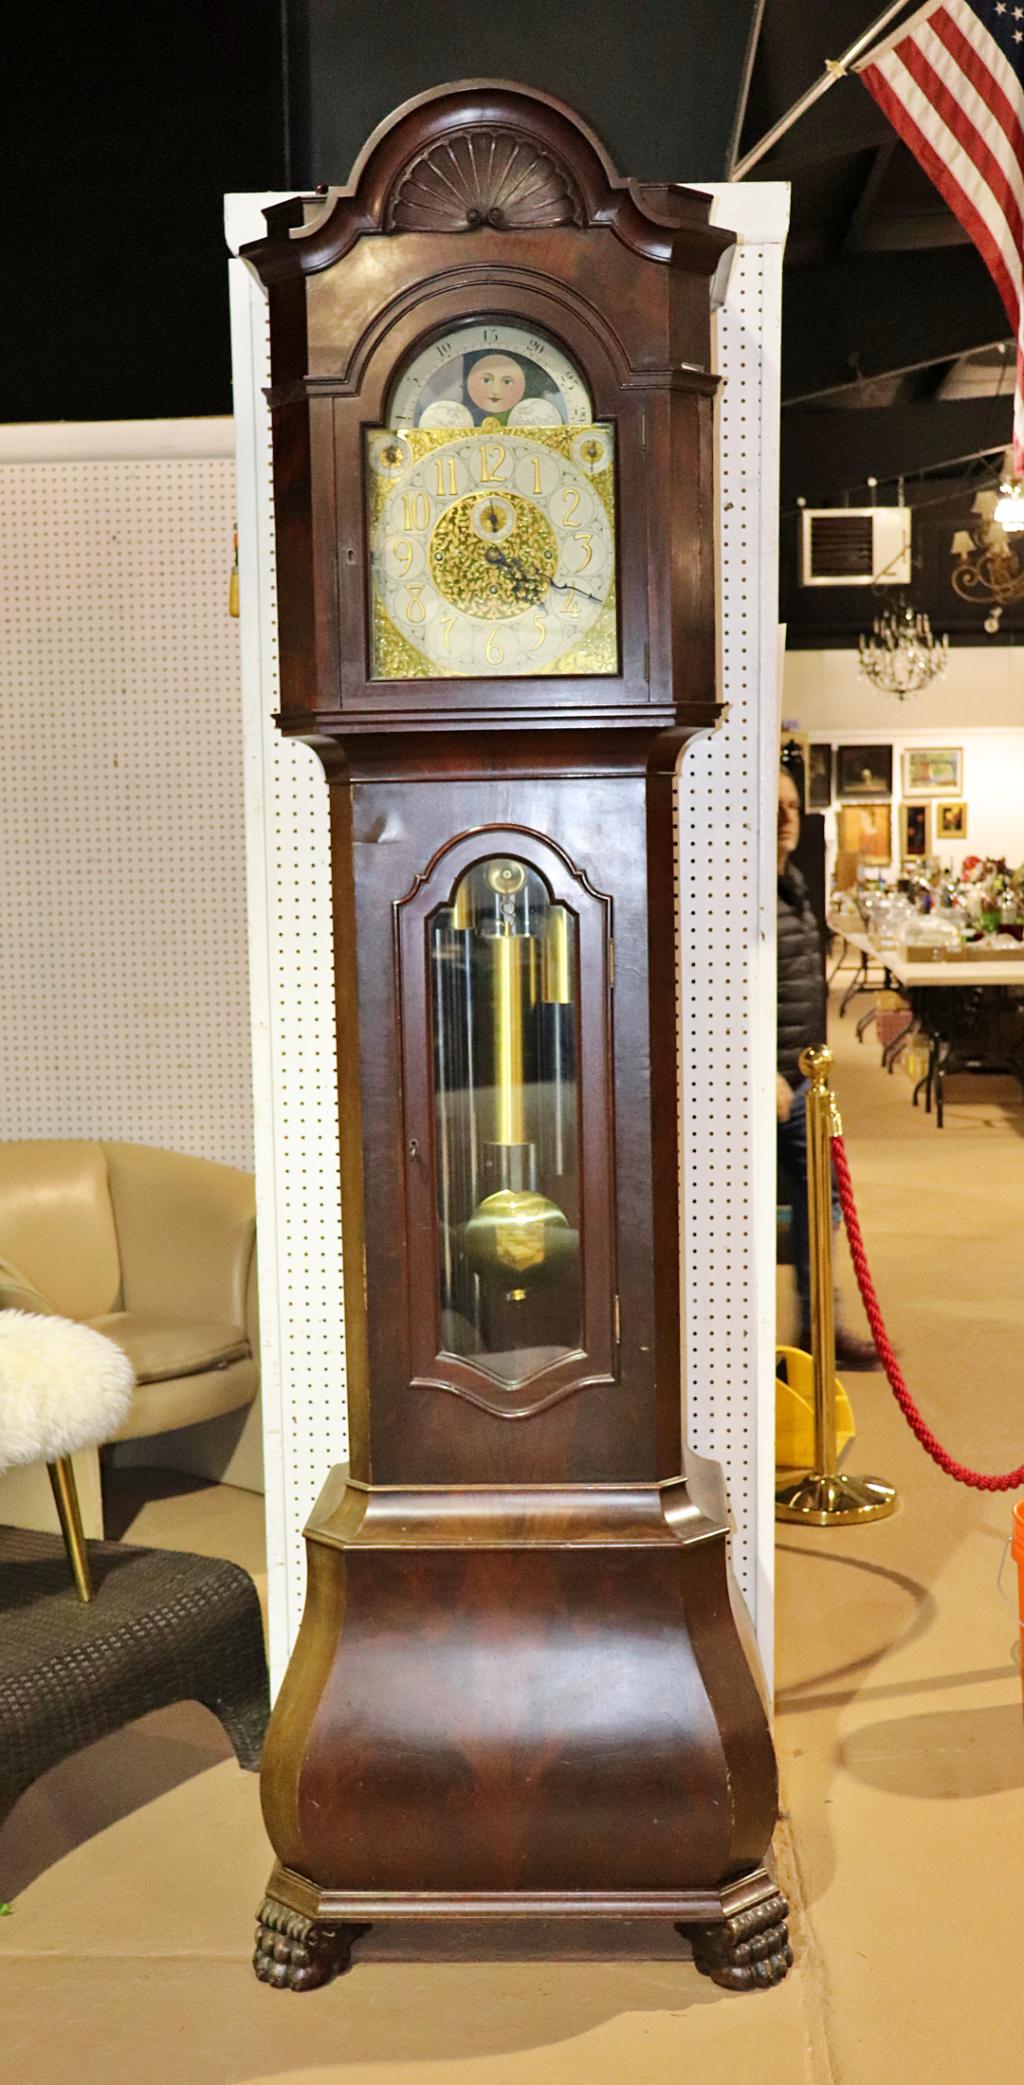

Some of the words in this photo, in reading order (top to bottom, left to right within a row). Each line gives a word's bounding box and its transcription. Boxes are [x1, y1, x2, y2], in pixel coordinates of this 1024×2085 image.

[436, 342, 452, 357] 10
[483, 329, 498, 342] 15
[435, 457, 458, 496] 11
[480, 442, 506, 482] 12
[531, 457, 543, 494] 1
[402, 492, 430, 532] 10
[562, 488, 581, 527] 2
[391, 538, 414, 578] 9
[574, 533, 593, 573] 3
[404, 584, 426, 625] 8
[560, 581, 581, 618] 4
[440, 616, 457, 656] 7
[485, 627, 506, 666] 6
[532, 612, 549, 652] 5
